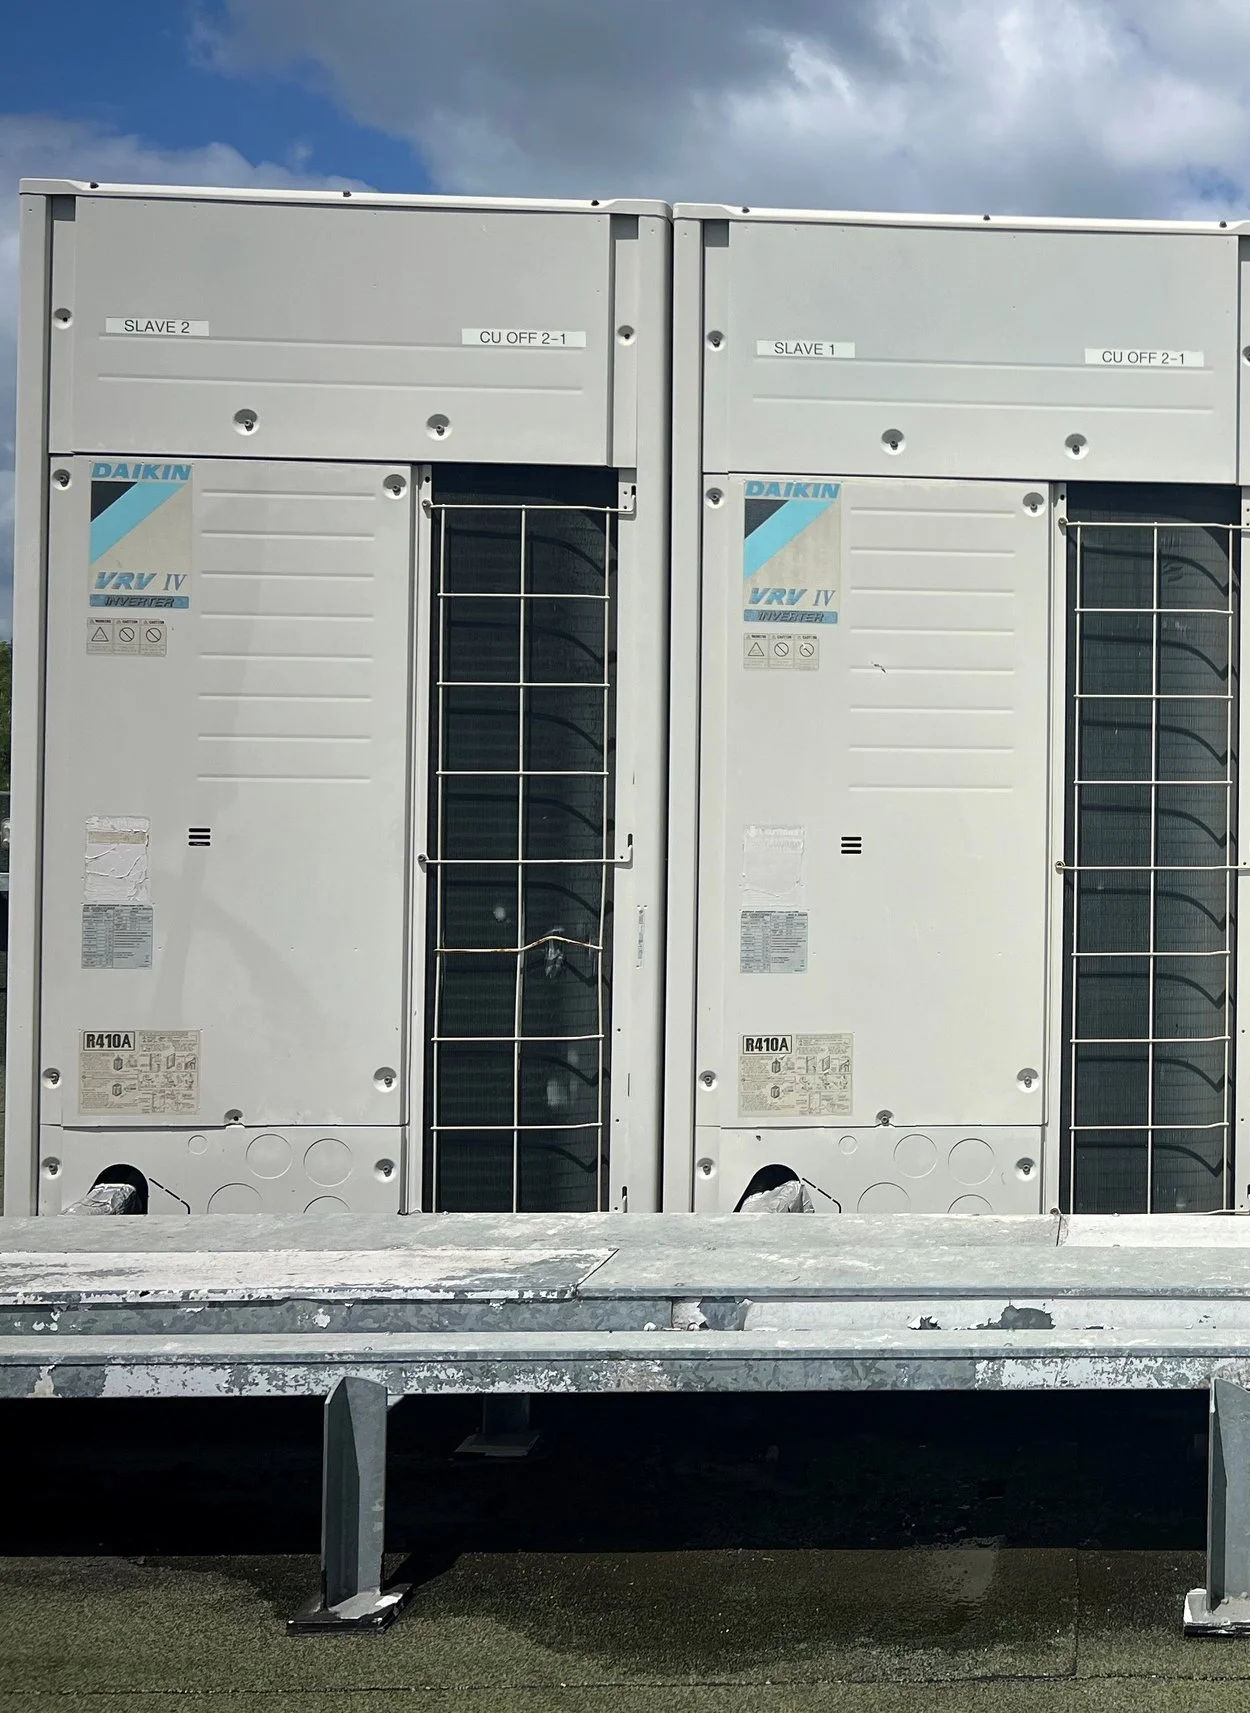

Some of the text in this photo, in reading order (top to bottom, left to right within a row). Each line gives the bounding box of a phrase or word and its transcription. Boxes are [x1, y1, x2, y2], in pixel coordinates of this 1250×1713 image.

[124, 319, 190, 334] SLAVE 2
[479, 330, 566, 345] CU OFF 2-1
[774, 341, 835, 356] SLAVE 1
[1102, 350, 1185, 365] CU OFF 2-1
[92, 462, 192, 481] DAIKIN
[745, 480, 841, 499] DAIKIN
[94, 571, 188, 592] VRV IV
[104, 595, 175, 608] INVERTER
[748, 587, 836, 607] VRV IV
[758, 610, 825, 623] INVERTER
[86, 1033, 132, 1049] R410A
[745, 1037, 790, 1052] R410A
